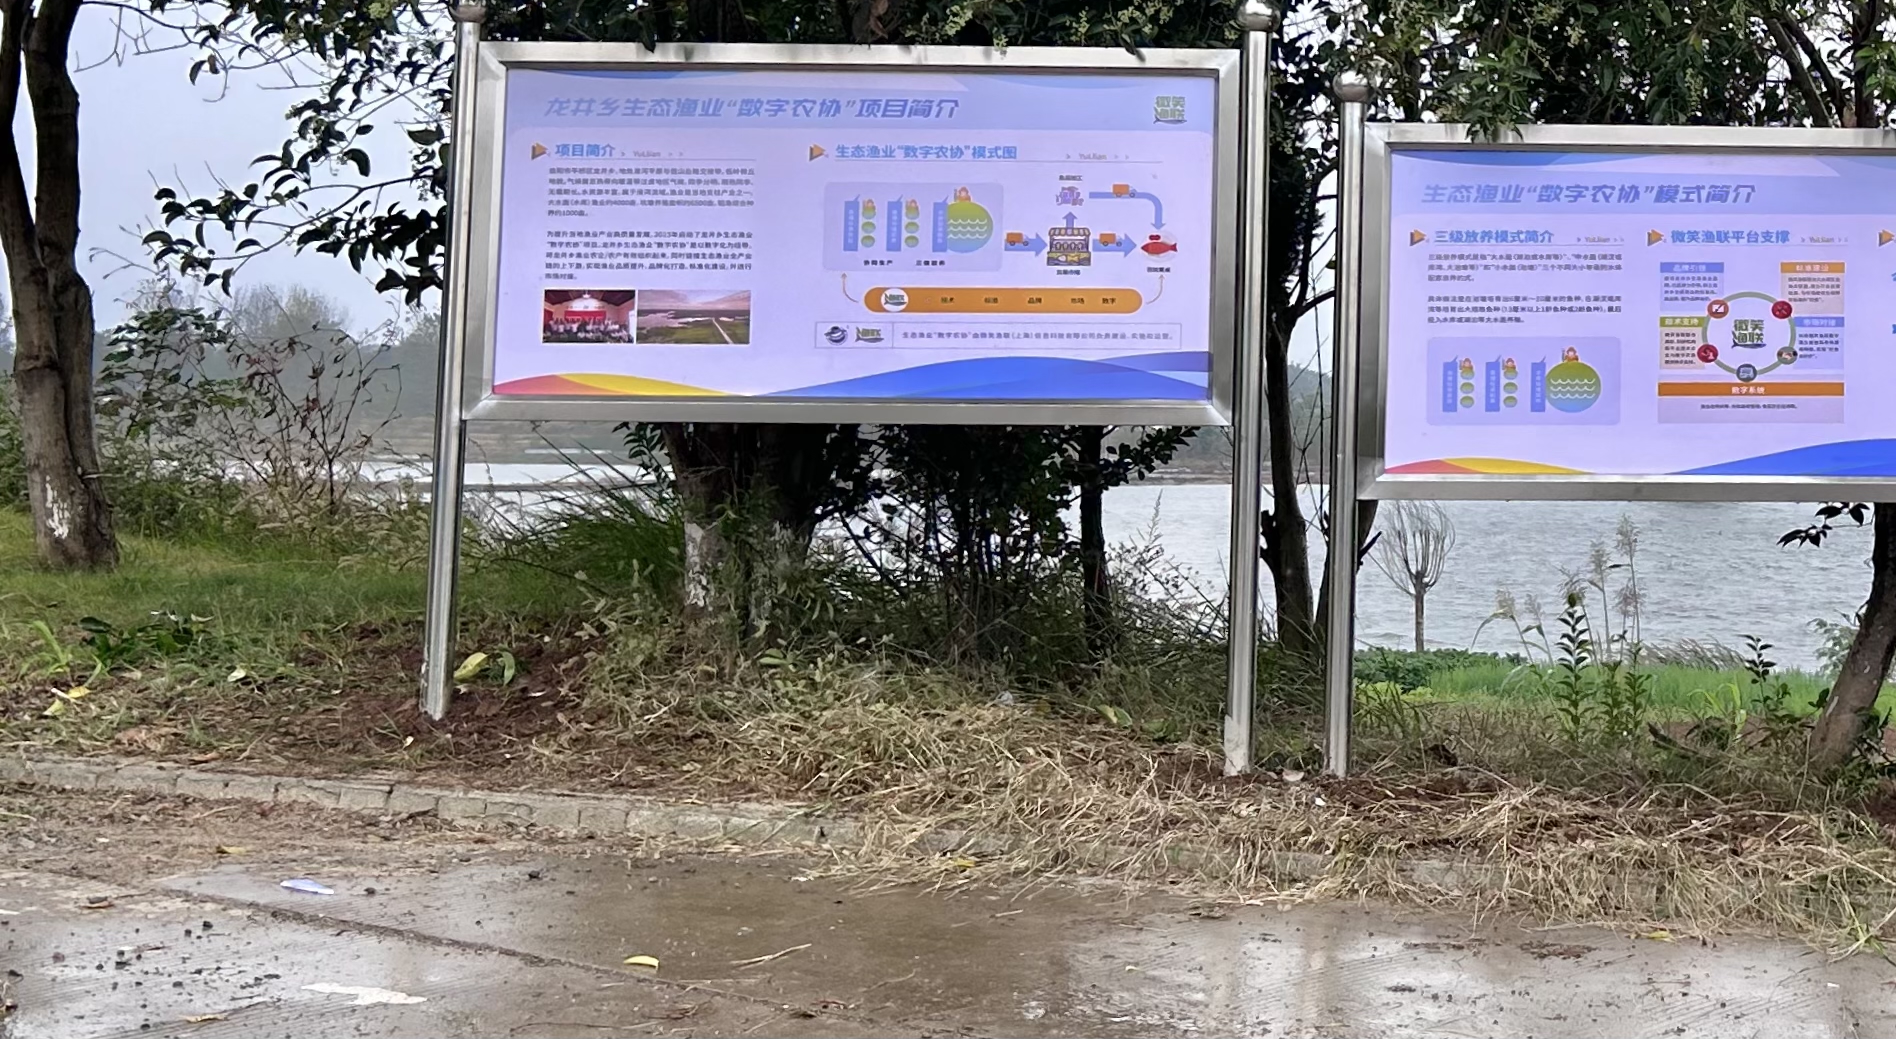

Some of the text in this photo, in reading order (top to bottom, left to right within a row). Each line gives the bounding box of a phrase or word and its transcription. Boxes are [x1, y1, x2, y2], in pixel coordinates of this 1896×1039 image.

[544, 97, 960, 119] 龙井乡生态渔业“数字农协”项目简介
[555, 143, 616, 158] 项目简介
[835, 144, 1018, 160] 生态渔业“数字农协”模式图
[1421, 184, 1757, 205] 生态渔业“数字农协”模式简介
[1434, 229, 1554, 244] 三级放养模式简介
[1671, 229, 1791, 244] 微笑渔联平台支撑
